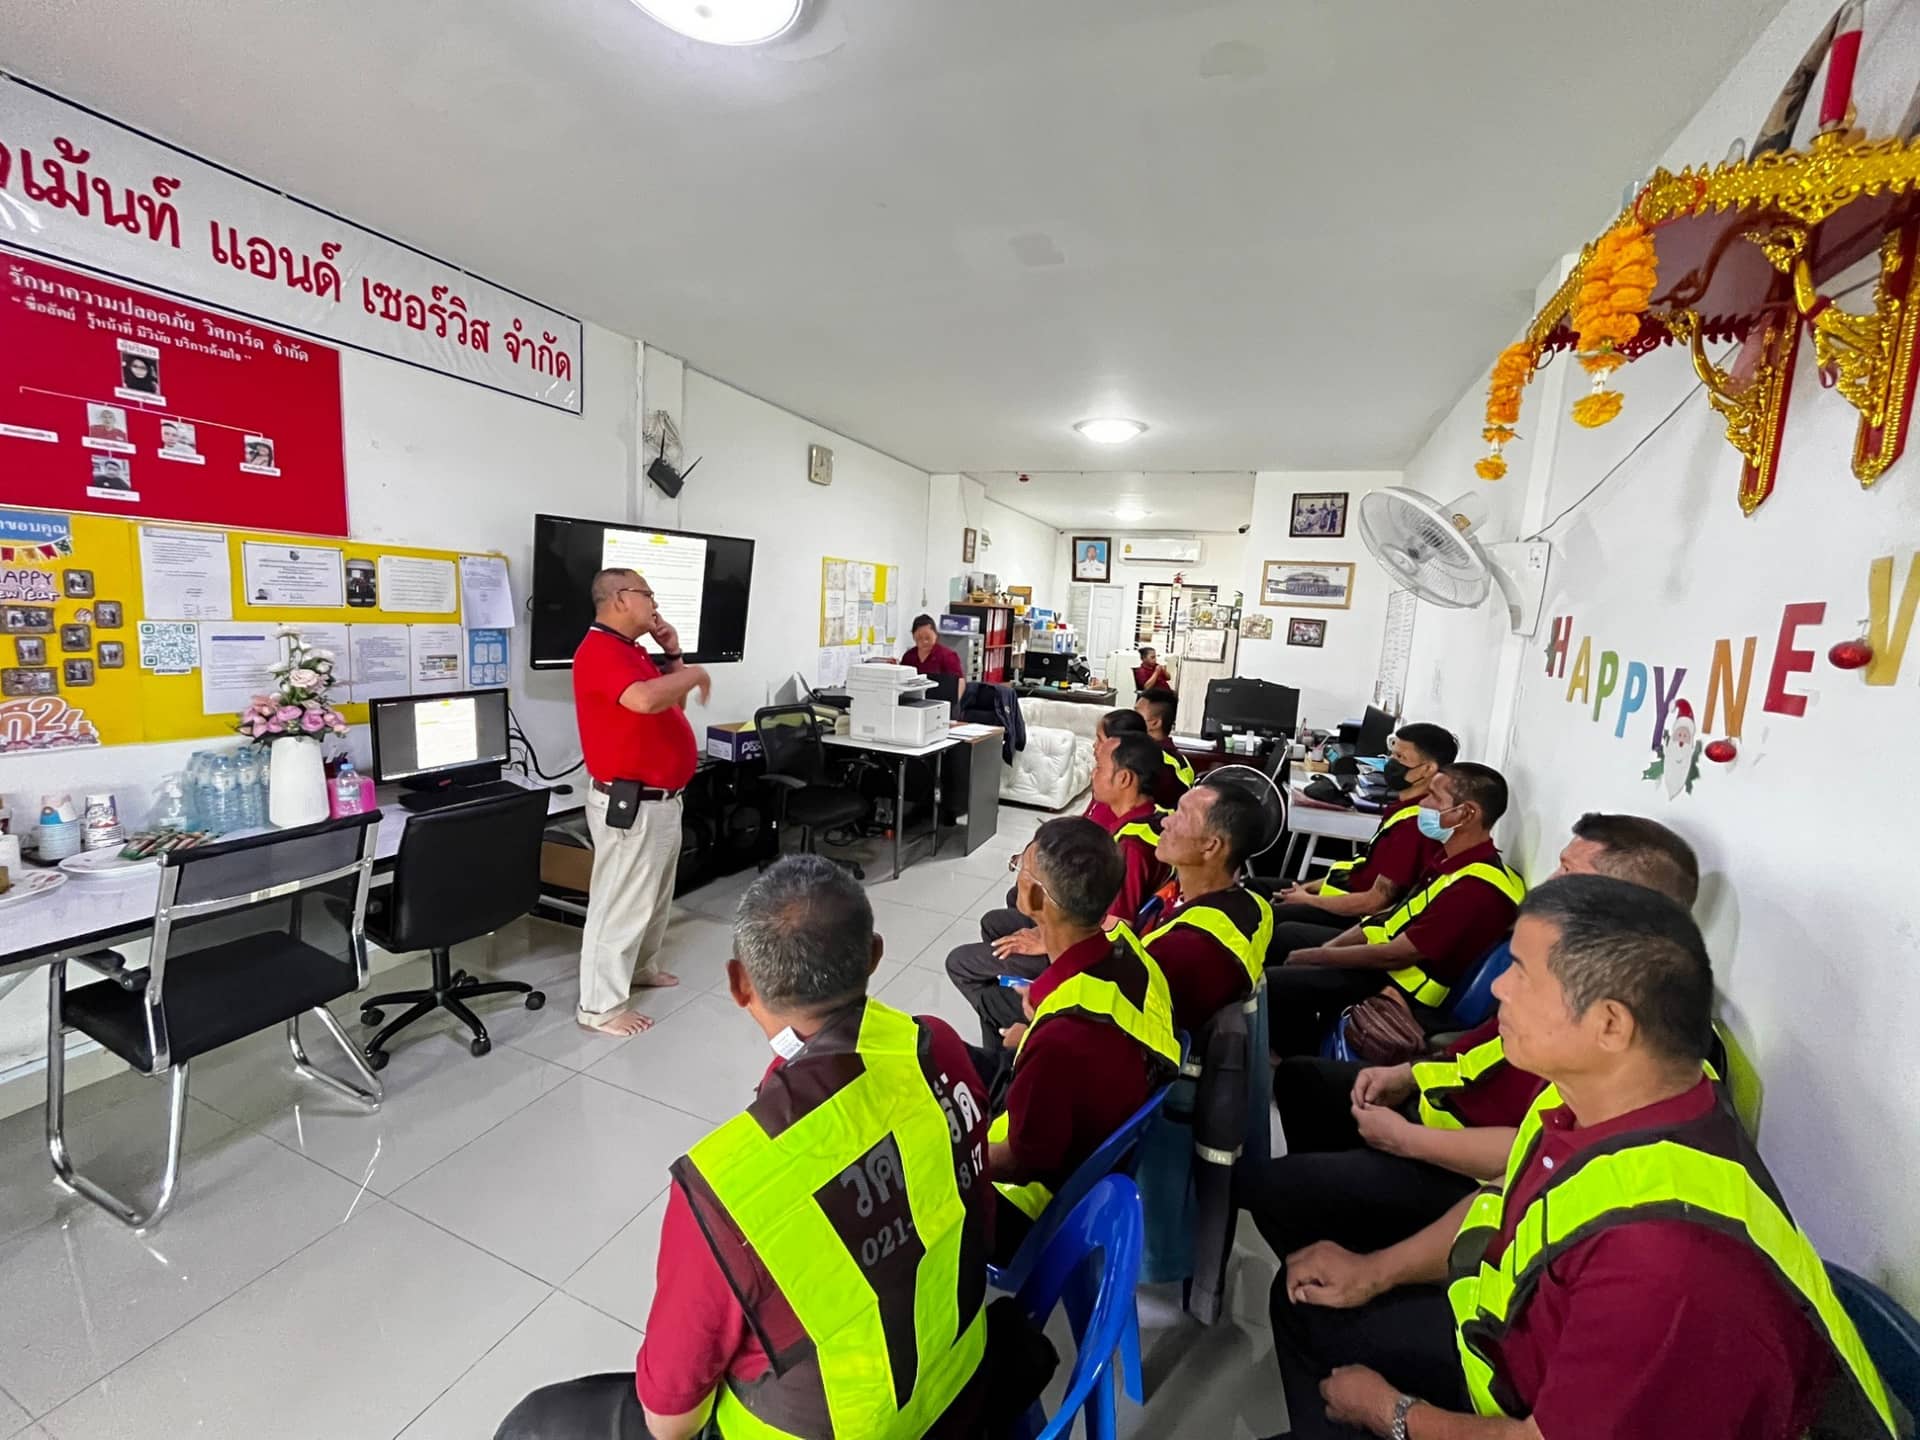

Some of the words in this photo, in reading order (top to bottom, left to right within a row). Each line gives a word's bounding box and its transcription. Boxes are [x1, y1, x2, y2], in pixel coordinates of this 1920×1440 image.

[8, 265, 195, 333] รักษาความปลอดภัย
[272, 339, 309, 362] จำกัด
[210, 220, 342, 303] แอนด์
[362, 276, 490, 354] เซอร์วิส
[503, 317, 571, 382] จำกัด
[0, 569, 53, 585] APPY
[1545, 615, 1688, 751] HAPPY
